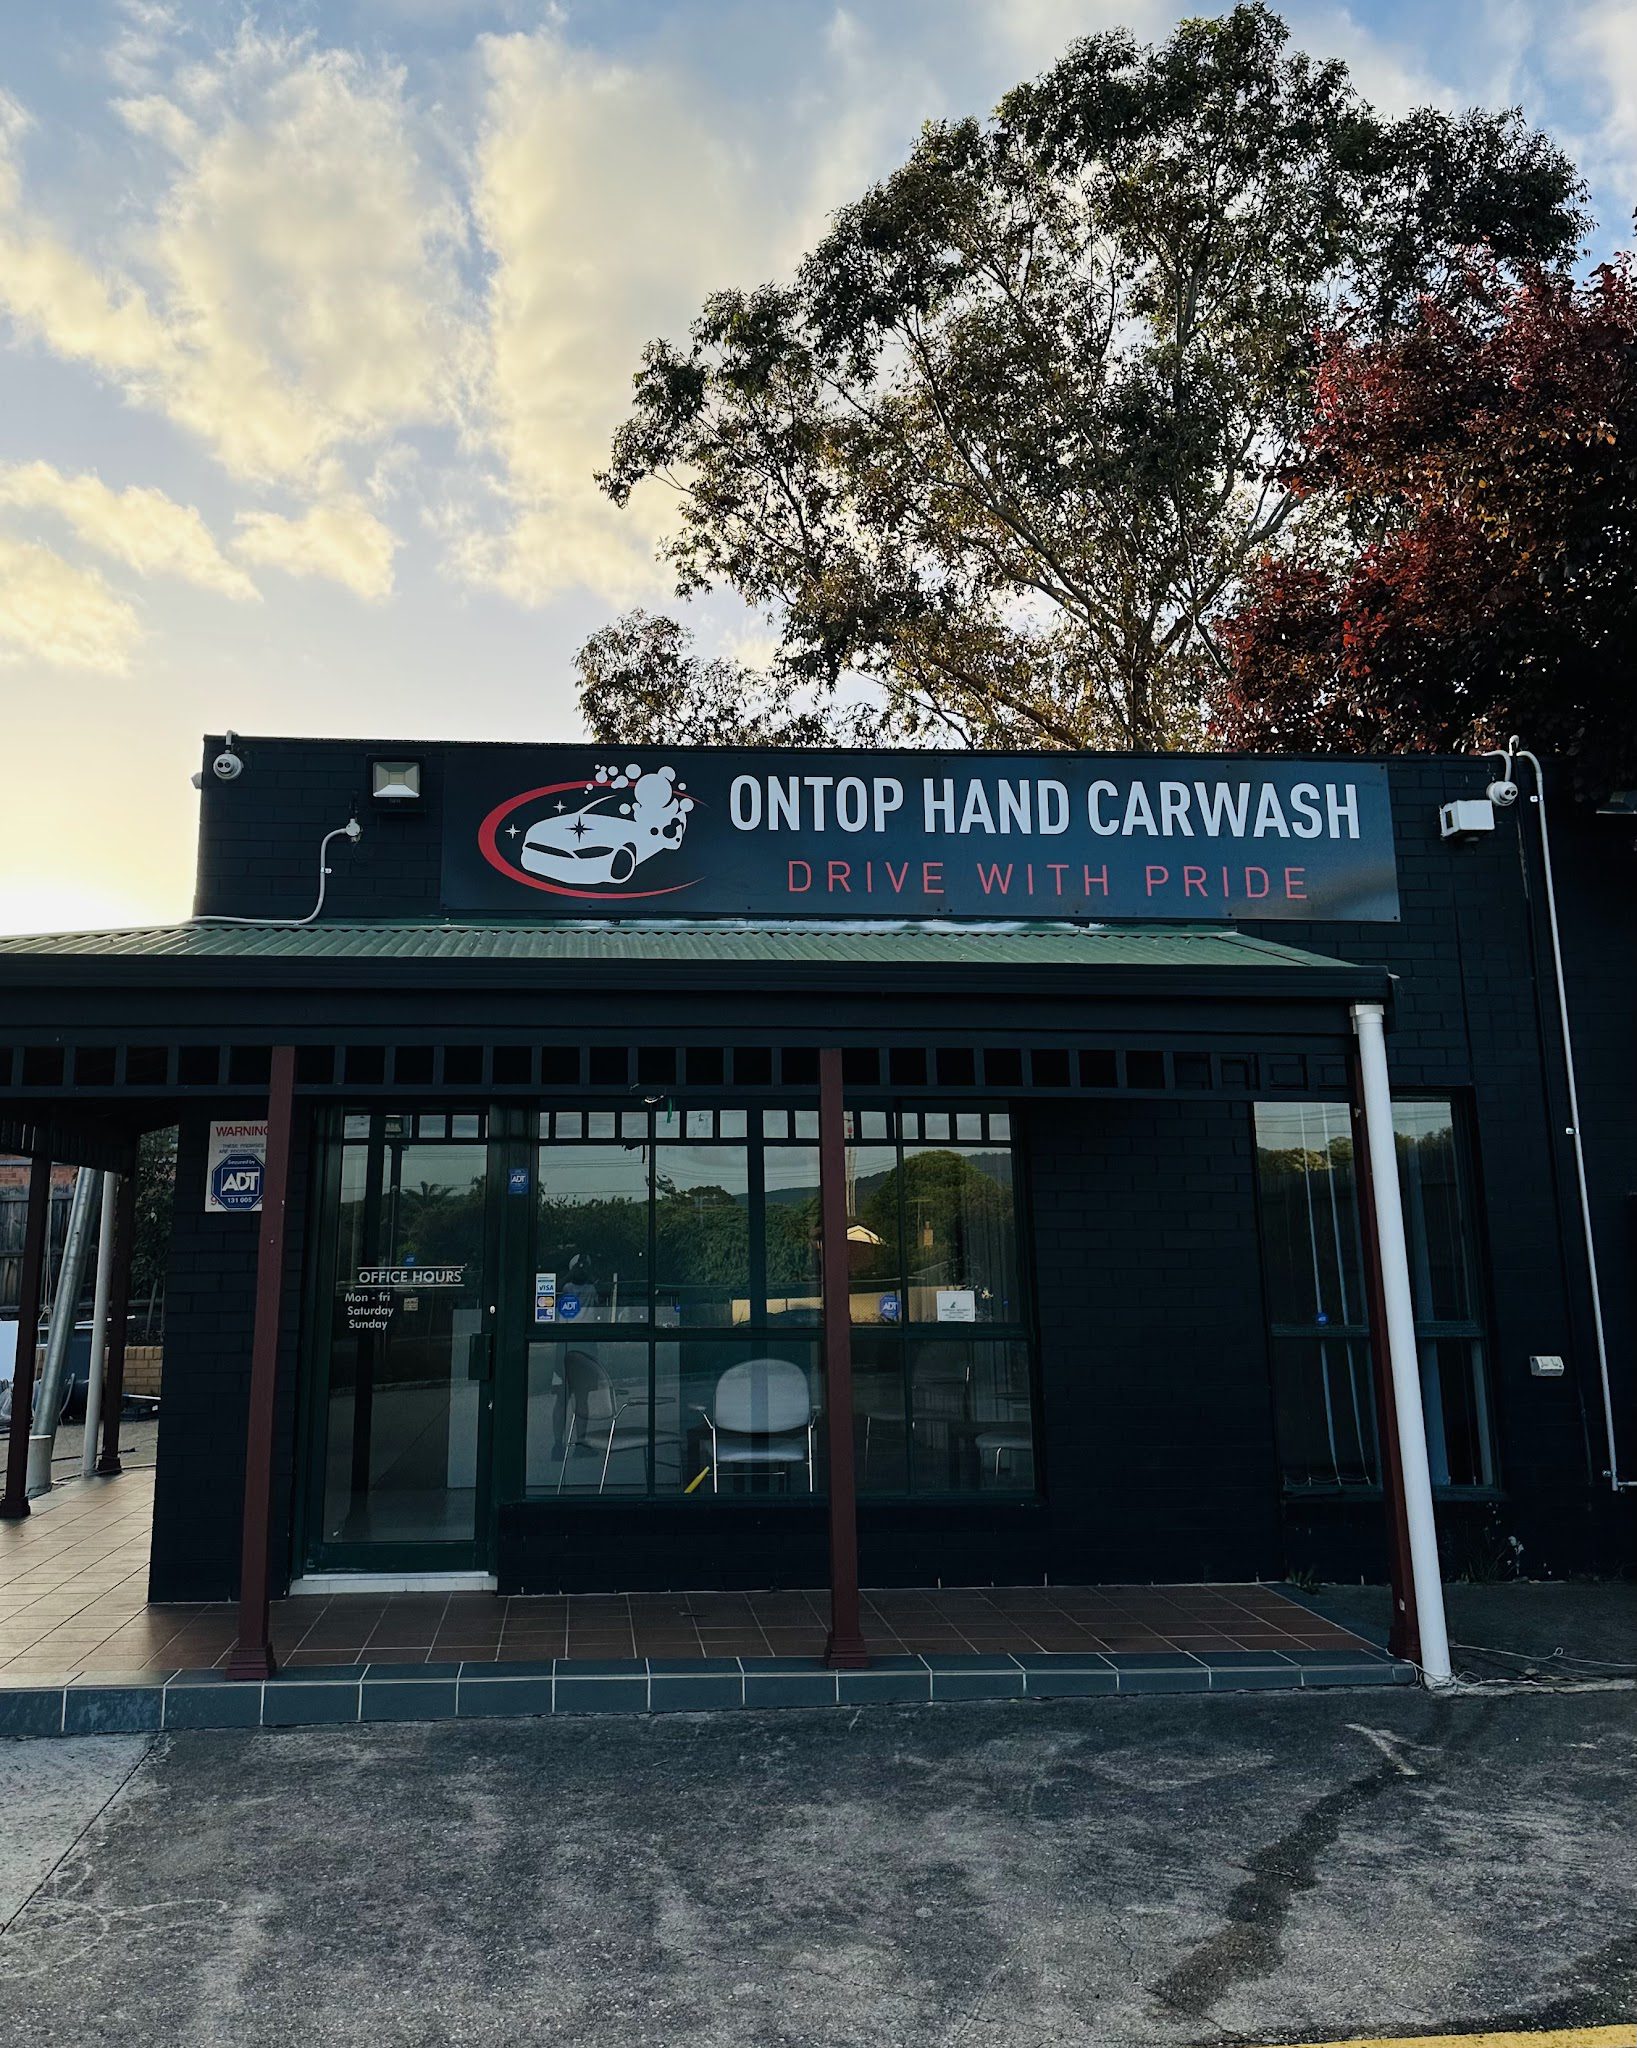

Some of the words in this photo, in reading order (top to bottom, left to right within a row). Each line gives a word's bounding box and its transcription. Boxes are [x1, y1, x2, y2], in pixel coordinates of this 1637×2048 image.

[730, 774, 904, 833] ONTOP
[922, 777, 1071, 836] HAND
[1087, 779, 1361, 840] CARWASH
[787, 860, 945, 895] DRIVE
[976, 863, 1110, 897] WITH
[1145, 864, 1309, 900] PRIDE
[222, 1172, 260, 1191] ADT
[359, 1271, 408, 1283] OFFICE
[412, 1270, 462, 1283] HOURS
[345, 1293, 368, 1302] Mon
[379, 1292, 391, 1301] fri
[347, 1306, 394, 1317] Saturday
[561, 1302, 577, 1310] ADT
[883, 1302, 898, 1311] ADT
[349, 1319, 388, 1330] Sunday
